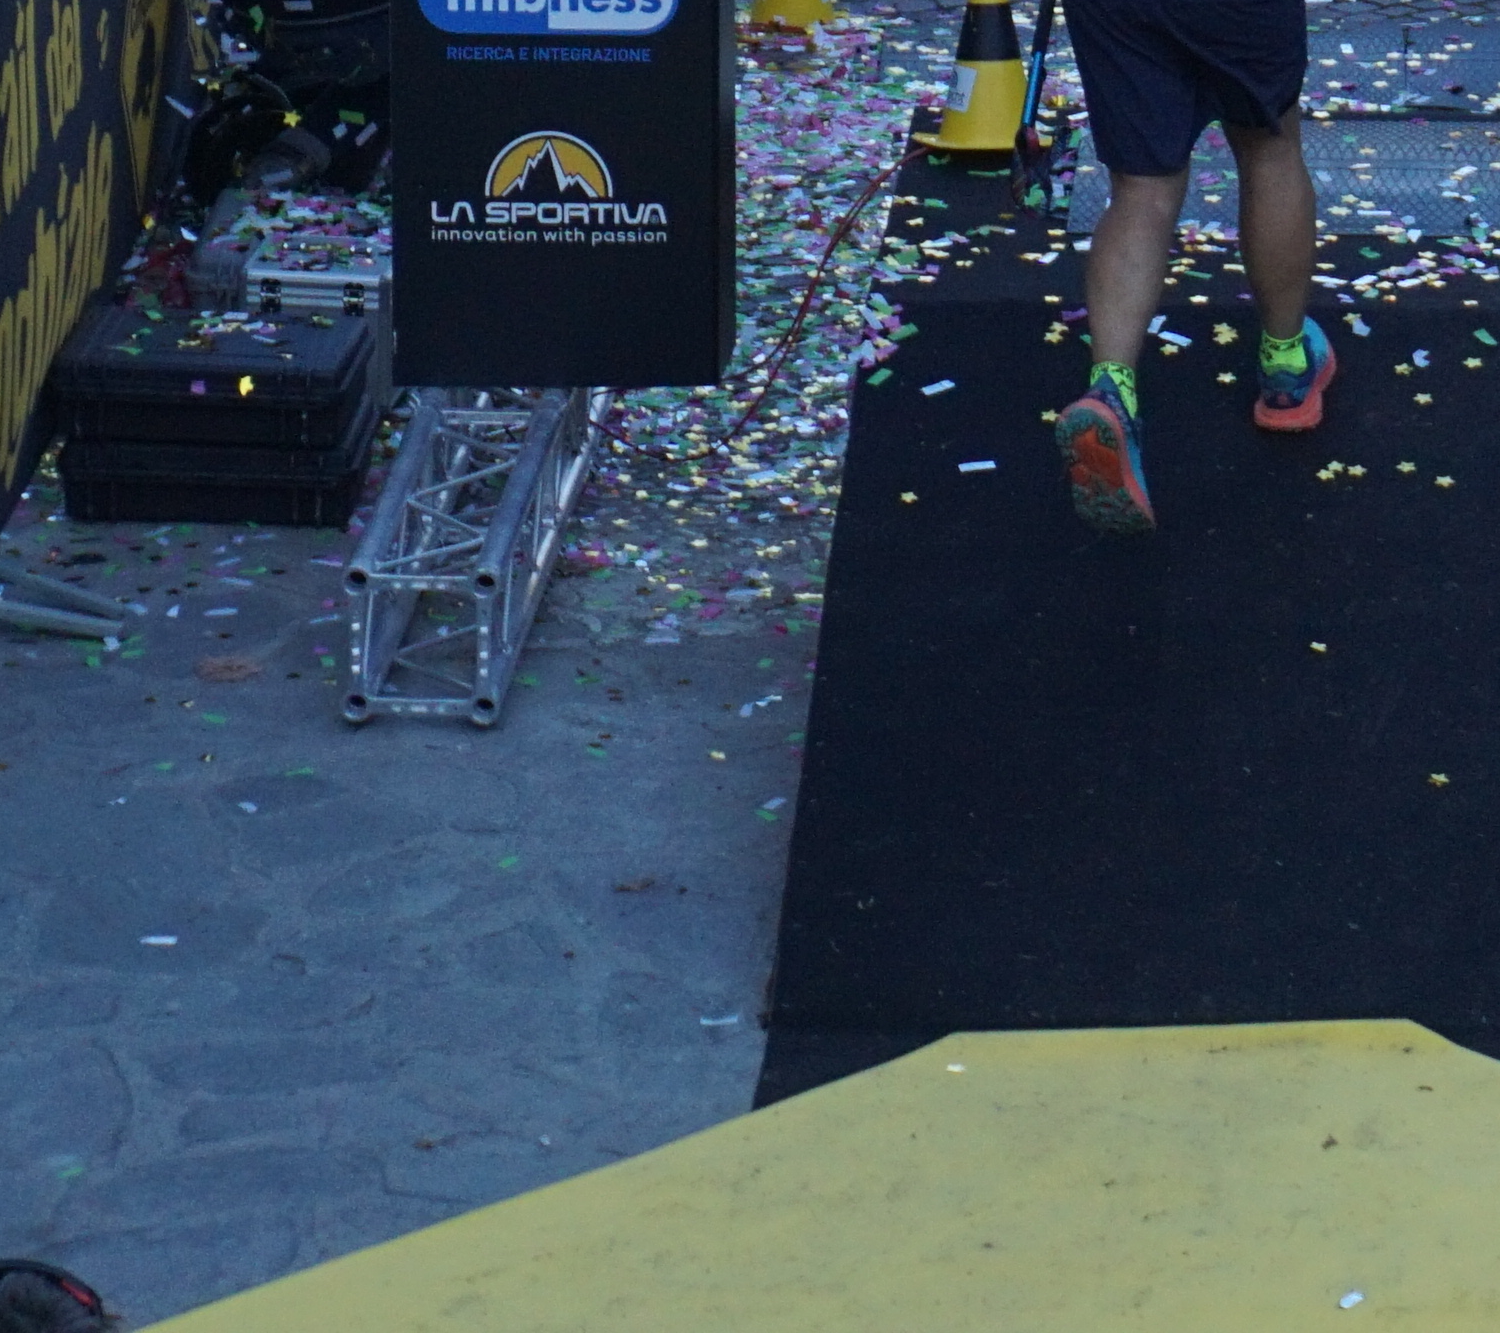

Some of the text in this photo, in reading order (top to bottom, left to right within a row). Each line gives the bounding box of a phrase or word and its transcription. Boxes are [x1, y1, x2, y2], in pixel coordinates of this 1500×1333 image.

[447, 47, 650, 62] RICERCA E INTEGRAZIONE
[432, 201, 667, 226] LA SPORTIVA
[432, 228, 666, 245] innovation with passion
